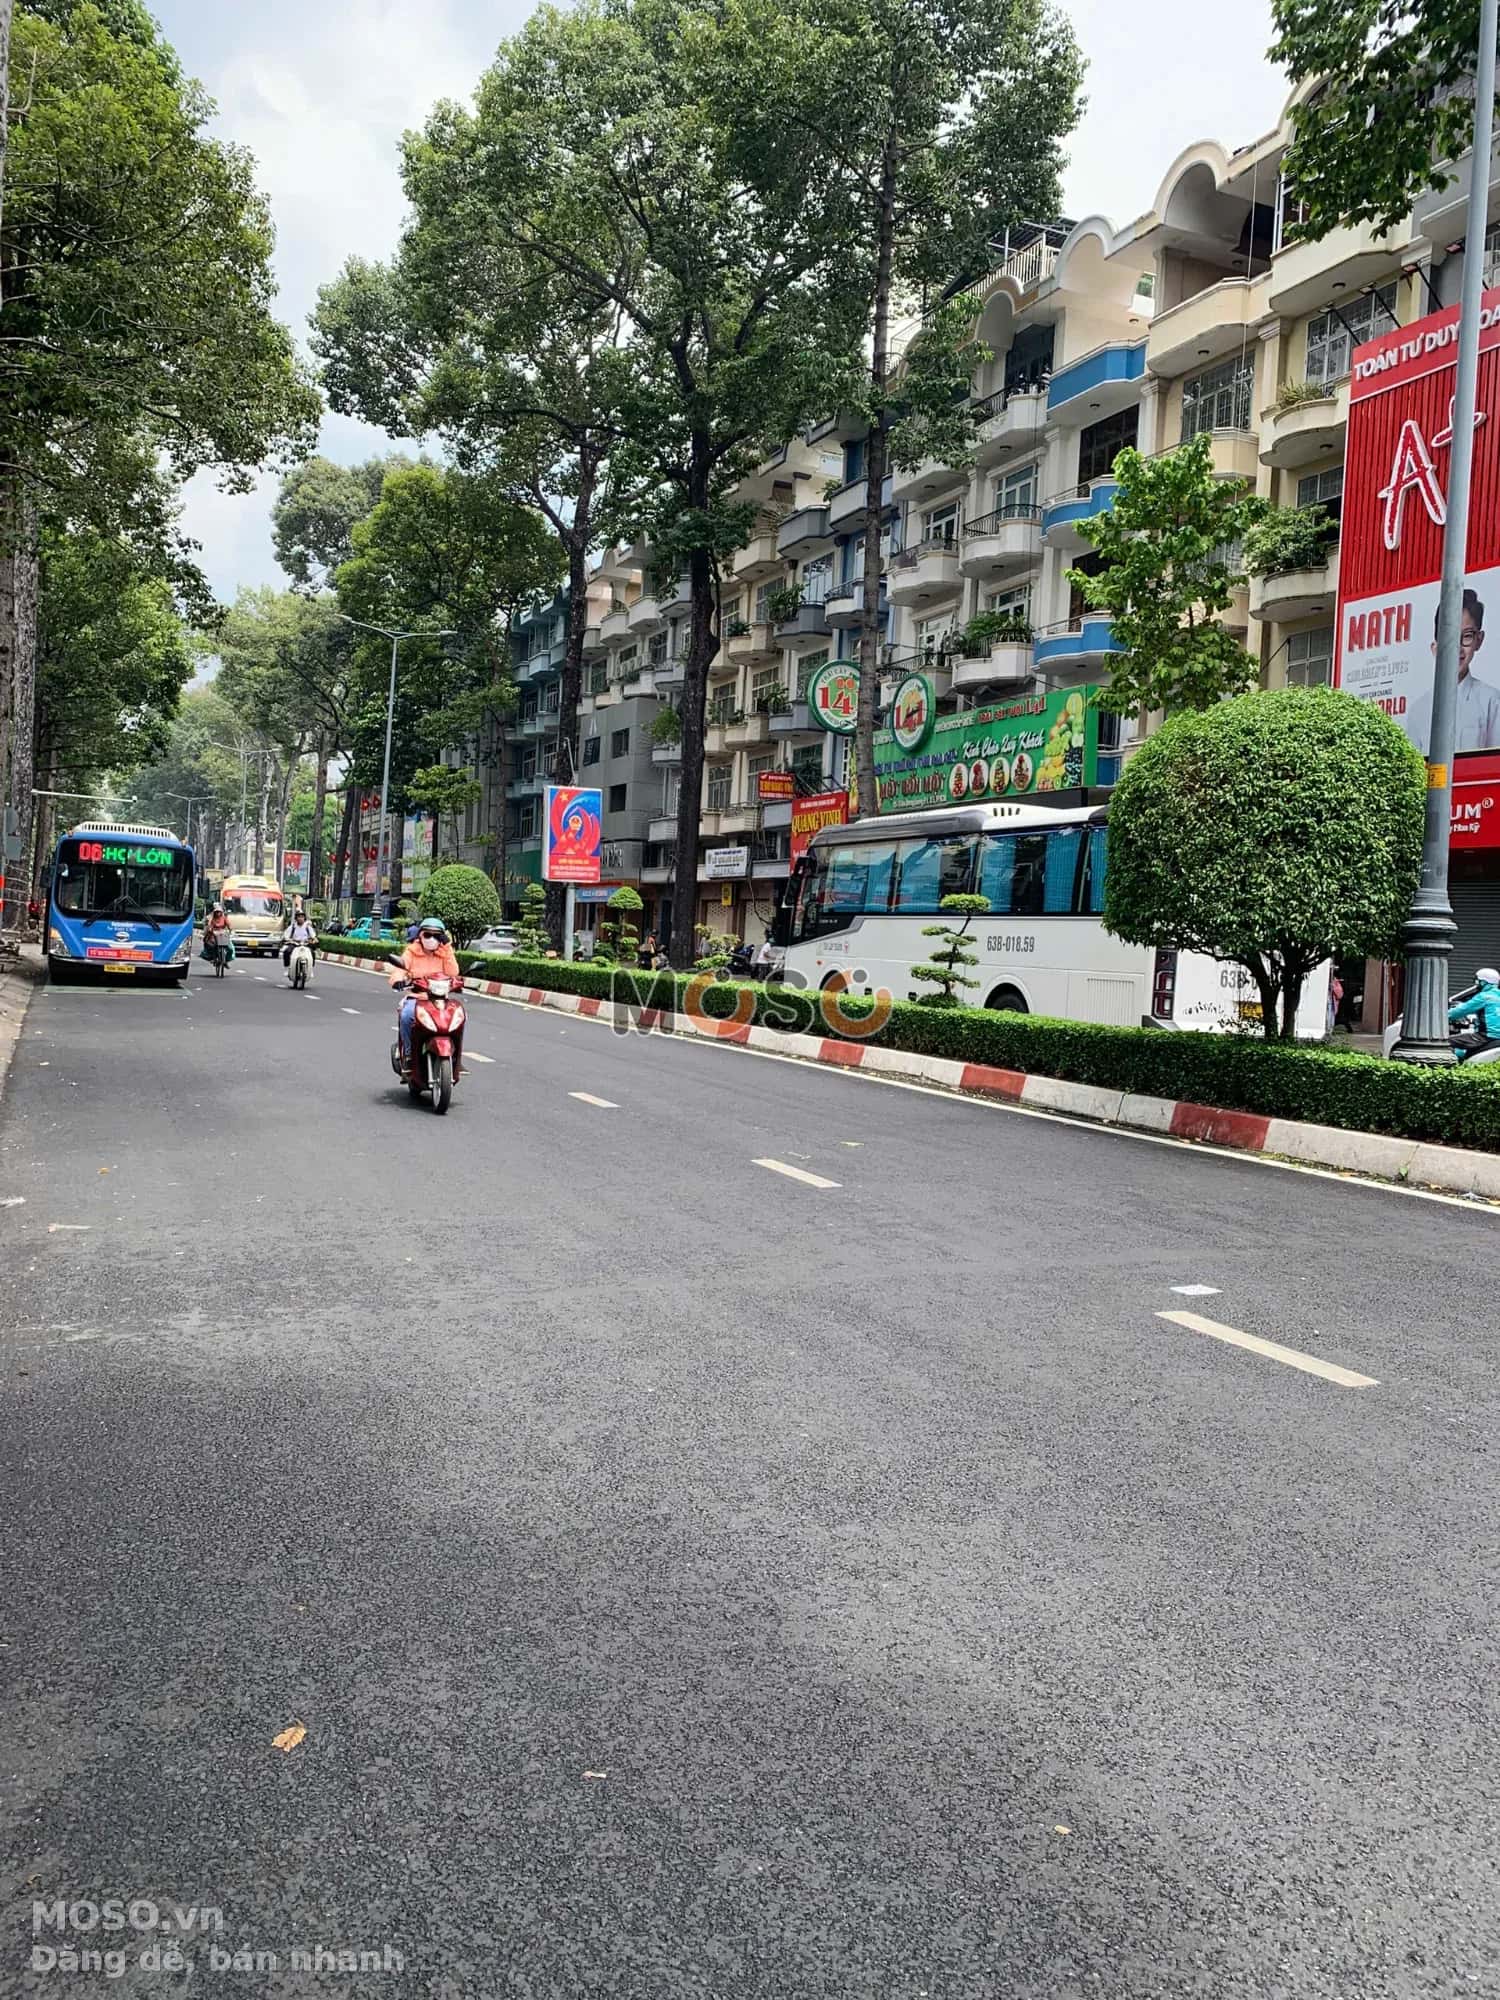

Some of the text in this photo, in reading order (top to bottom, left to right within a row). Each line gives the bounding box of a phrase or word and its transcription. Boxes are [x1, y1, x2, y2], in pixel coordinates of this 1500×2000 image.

[1354, 347, 1399, 381] TOÁN
[1400, 332, 1425, 362] TƯ
[1425, 320, 1461, 353] DUY
[1347, 602, 1412, 653] MATH
[818, 686, 859, 715] 14
[1376, 696, 1407, 716] ORLD
[1018, 728, 1046, 750] Khách
[791, 809, 841, 833] QUANG VINH
[80, 842, 103, 861] 06
[987, 936, 1035, 953] 63B-018.59
